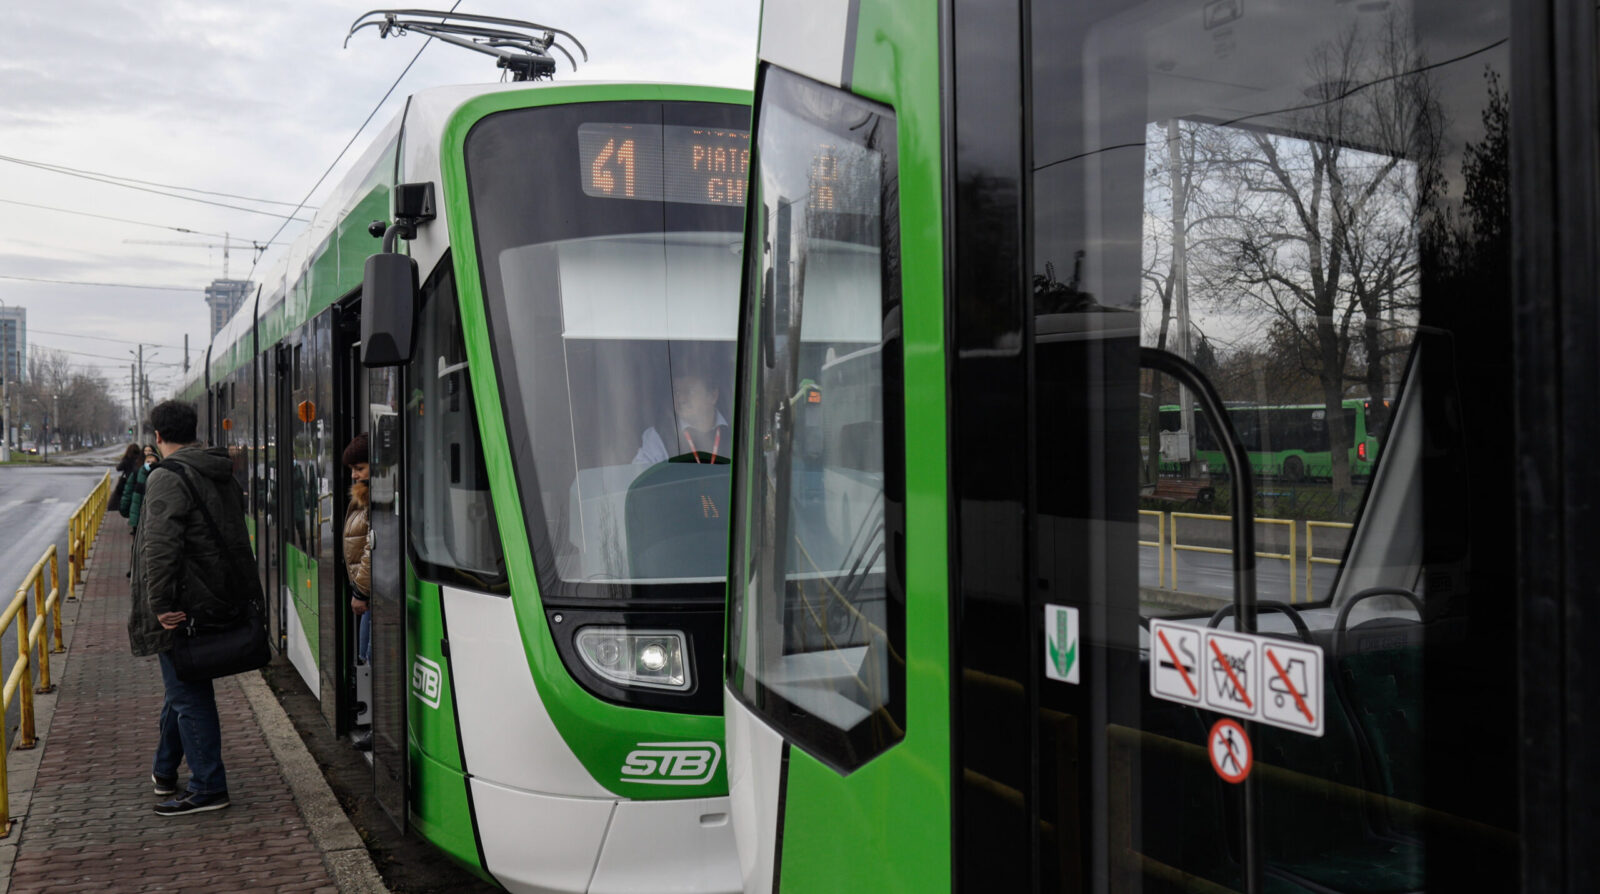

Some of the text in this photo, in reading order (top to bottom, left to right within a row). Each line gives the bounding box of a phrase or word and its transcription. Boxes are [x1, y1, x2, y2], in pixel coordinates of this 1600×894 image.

[692, 144, 750, 173] PIATA
[707, 177, 748, 204] GH
[412, 661, 439, 699] STB
[620, 749, 712, 777] STB
